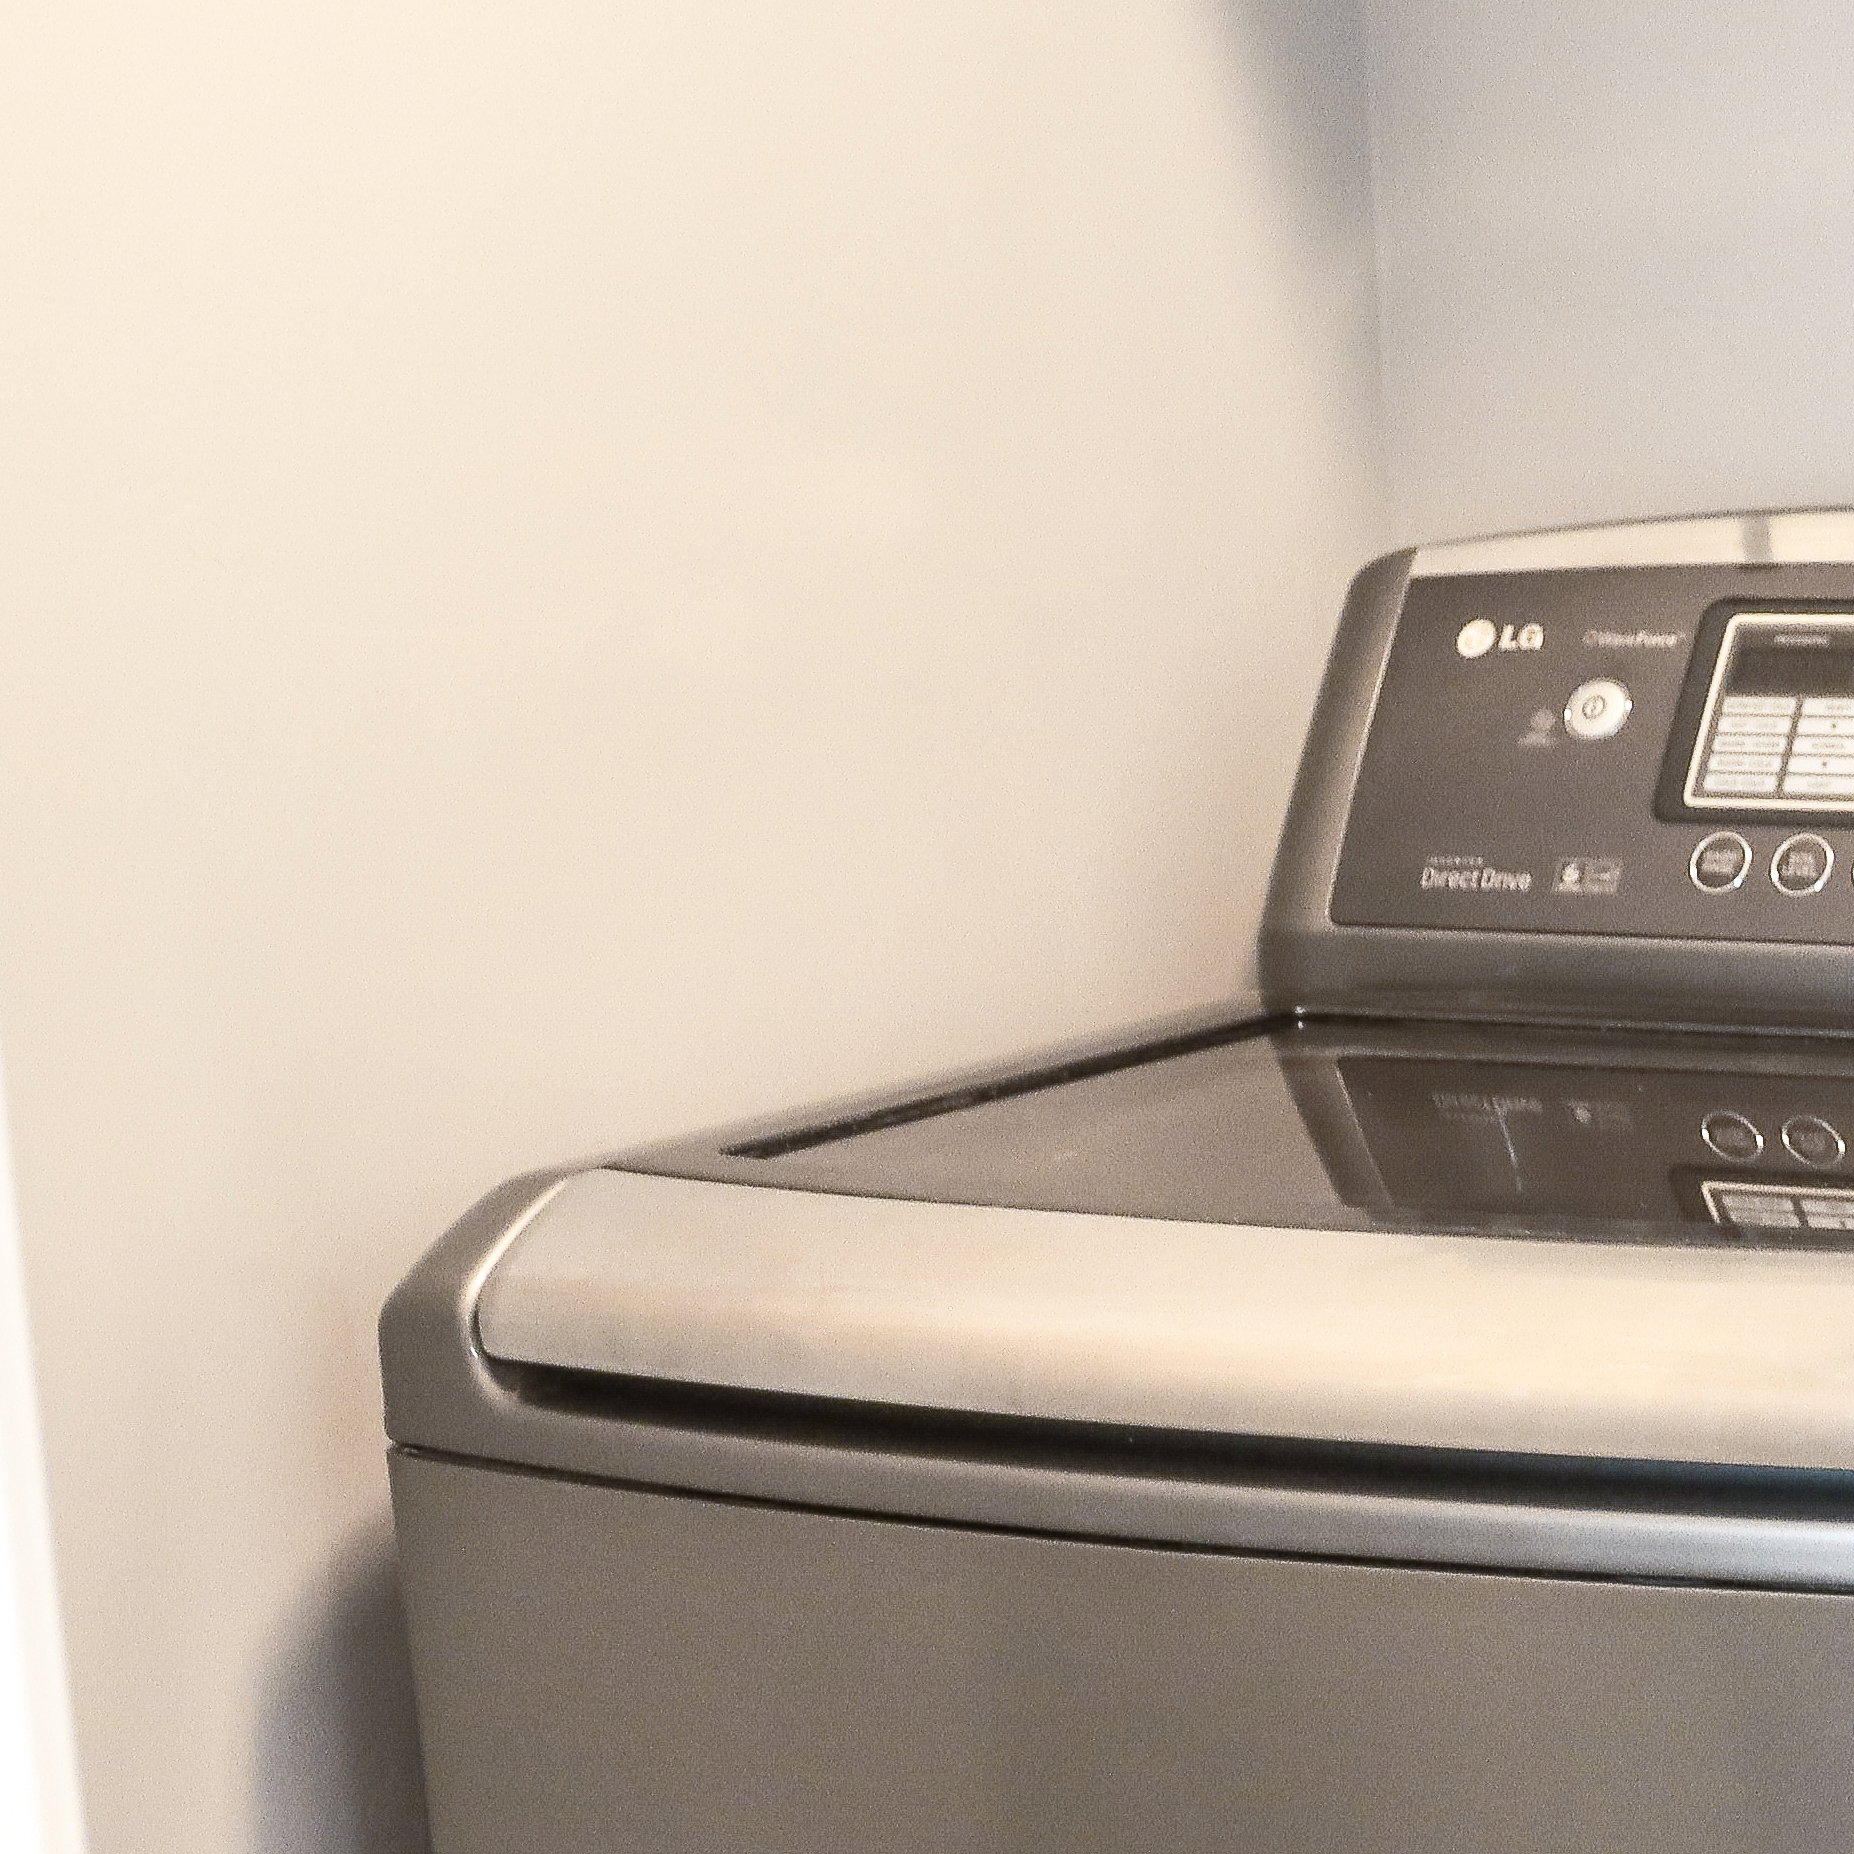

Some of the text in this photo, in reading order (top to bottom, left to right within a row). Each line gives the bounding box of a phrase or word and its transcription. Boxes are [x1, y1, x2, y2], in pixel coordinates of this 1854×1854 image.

[1498, 623, 1544, 650] LG
[1420, 867, 1533, 892] Direct Drive
